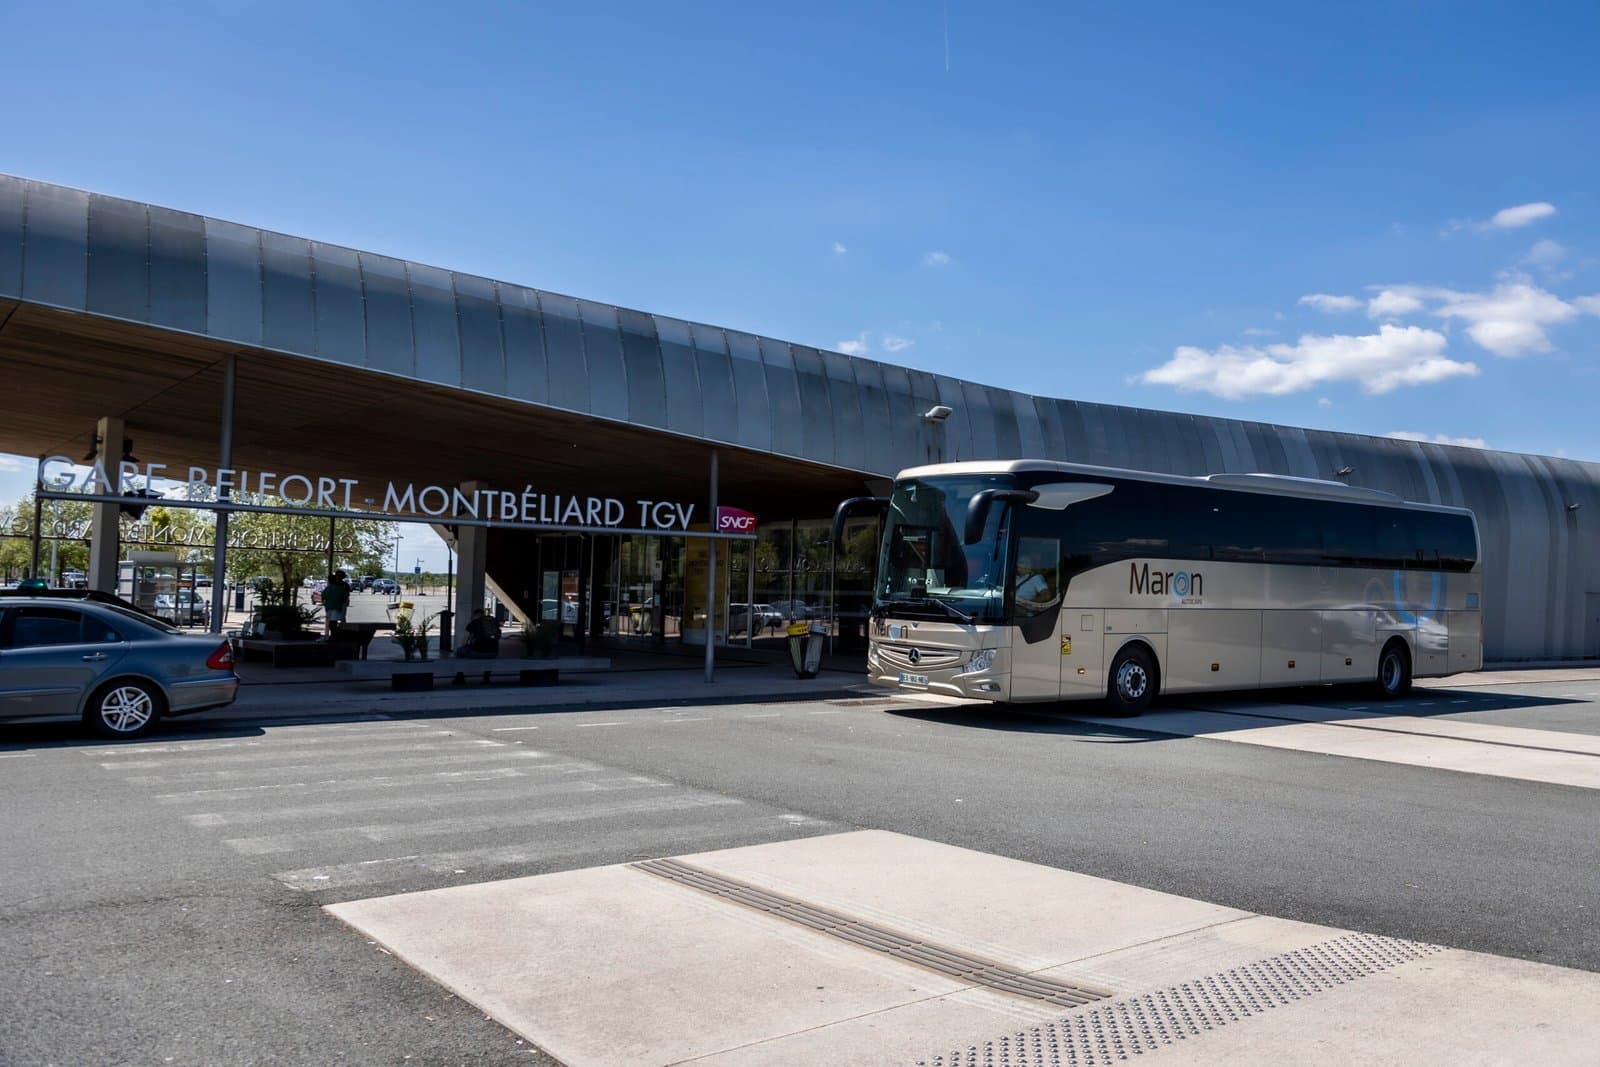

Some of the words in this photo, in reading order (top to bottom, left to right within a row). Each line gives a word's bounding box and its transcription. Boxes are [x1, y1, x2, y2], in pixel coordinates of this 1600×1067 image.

[39, 455, 167, 496] GARE
[188, 466, 359, 511] BELFORT
[383, 481, 625, 525] MONTBÉLIARD
[637, 500, 695, 530] TGV
[720, 516, 755, 529] SNCF
[1129, 562, 1203, 597] Maron
